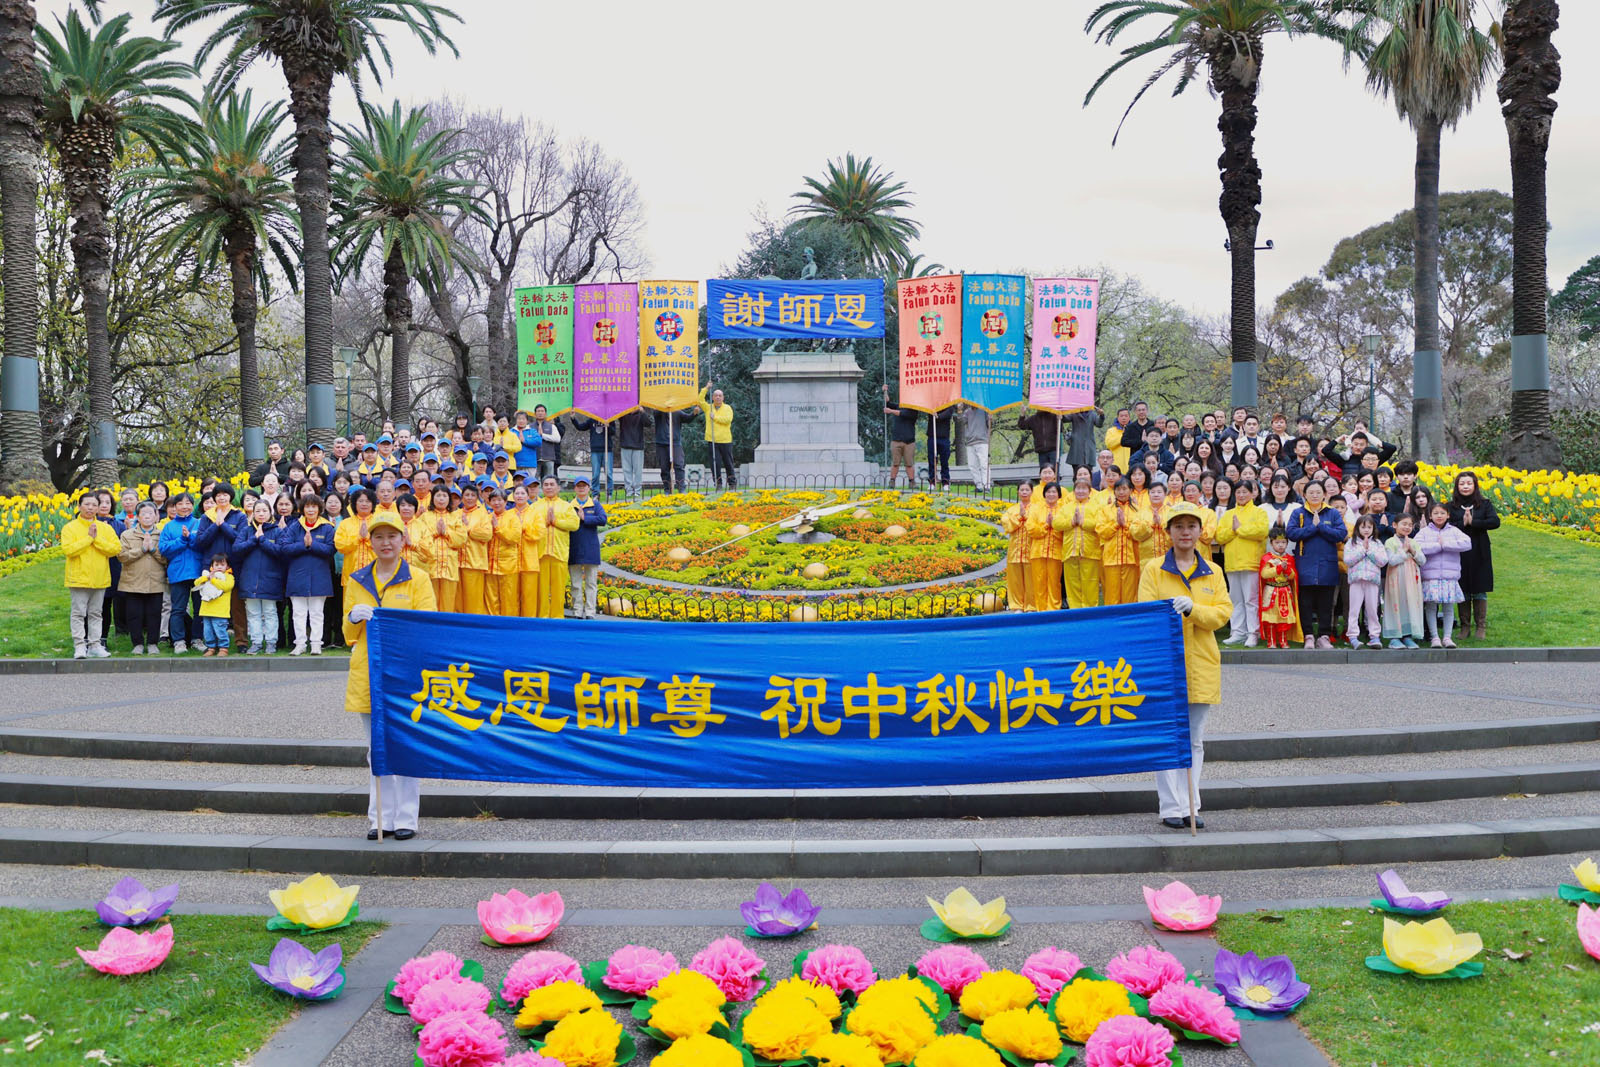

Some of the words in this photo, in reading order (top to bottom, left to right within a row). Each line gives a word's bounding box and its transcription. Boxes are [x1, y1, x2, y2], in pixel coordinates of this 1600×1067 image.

[642, 286, 694, 296] 法輪大法
[903, 282, 956, 298] 法輪大法
[968, 280, 1020, 293] 法輪大法
[1038, 284, 1093, 297] 法輪大法
[519, 291, 569, 305] 法輪大法
[643, 298, 669, 309] Falun
[673, 298, 694, 310] Dafa
[904, 298, 930, 310] Falun
[933, 294, 956, 305] Dafa
[968, 294, 995, 305] Falun
[998, 294, 1020, 306] Dafa
[1039, 297, 1066, 308] Falun
[1071, 298, 1092, 310] Dafa
[521, 307, 544, 318] Falun
[548, 305, 568, 316] Dafa
[580, 303, 605, 314] Falun
[608, 302, 631, 313] Dafa
[719, 291, 875, 329] 謝師恩
[789, 405, 817, 413] EDWARD
[410, 661, 727, 738] 感恩師尊
[760, 656, 1146, 740] 祝中秋快樂
